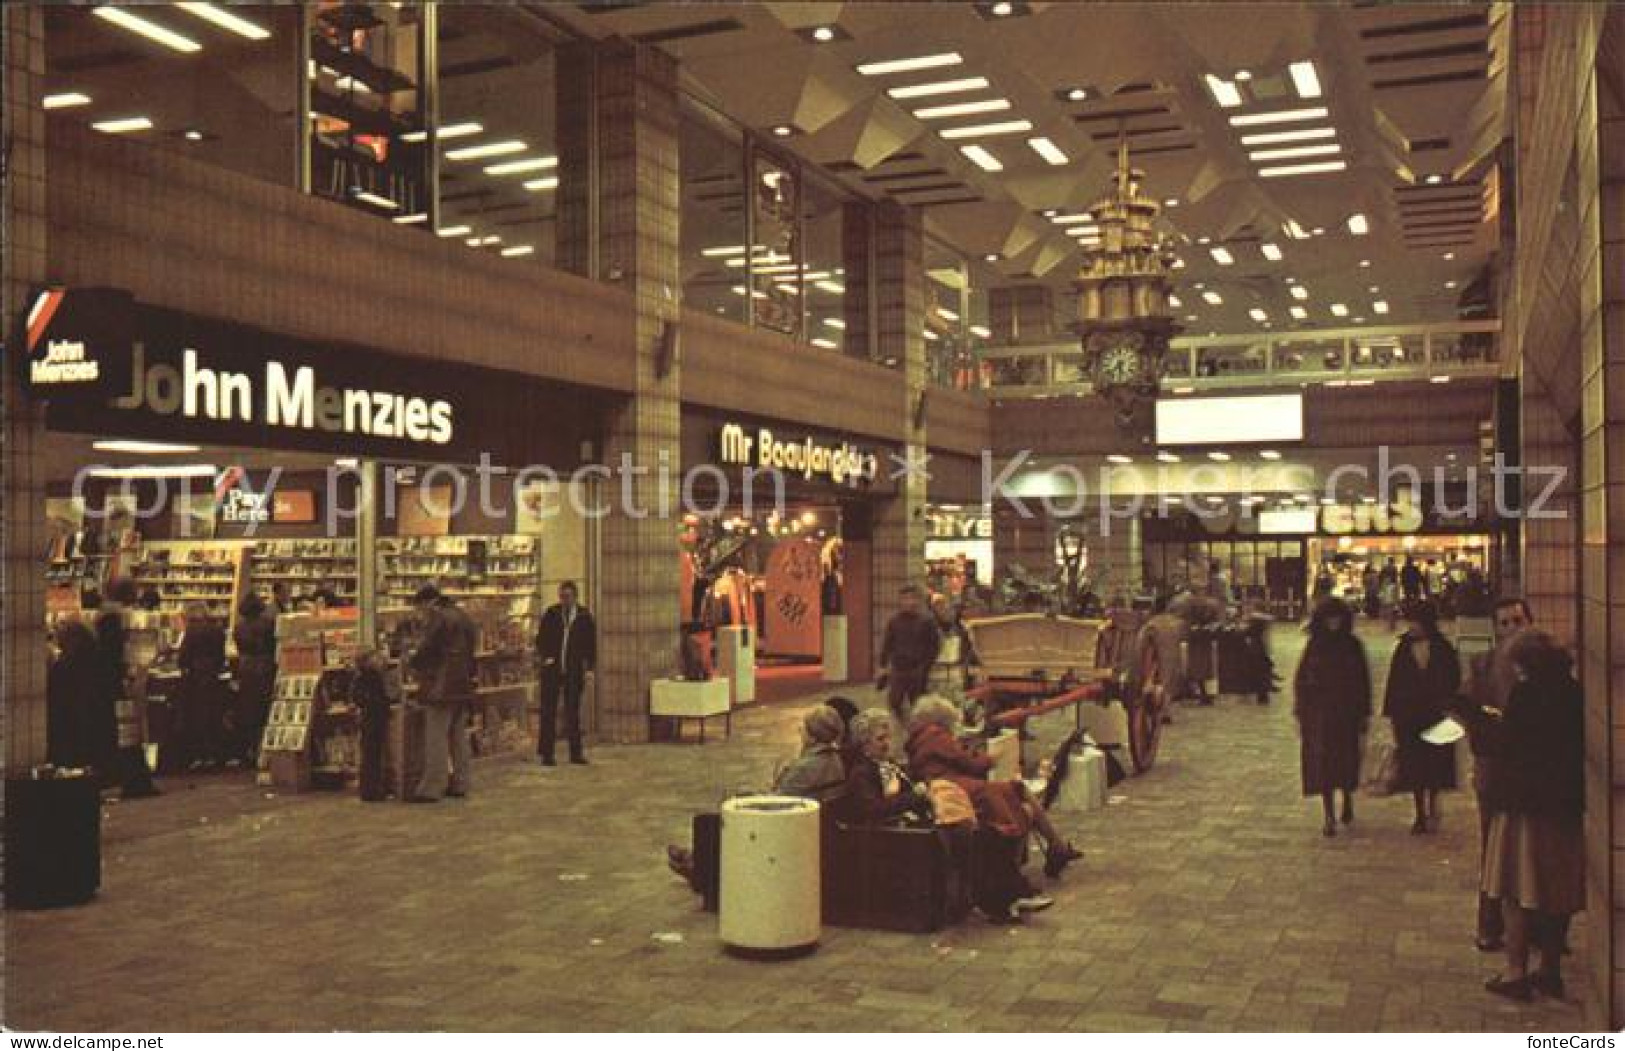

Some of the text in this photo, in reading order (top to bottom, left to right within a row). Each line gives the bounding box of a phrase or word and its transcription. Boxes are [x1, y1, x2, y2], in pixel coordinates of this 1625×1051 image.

[112, 340, 453, 444] John Menzies
[721, 423, 752, 464] Mr
